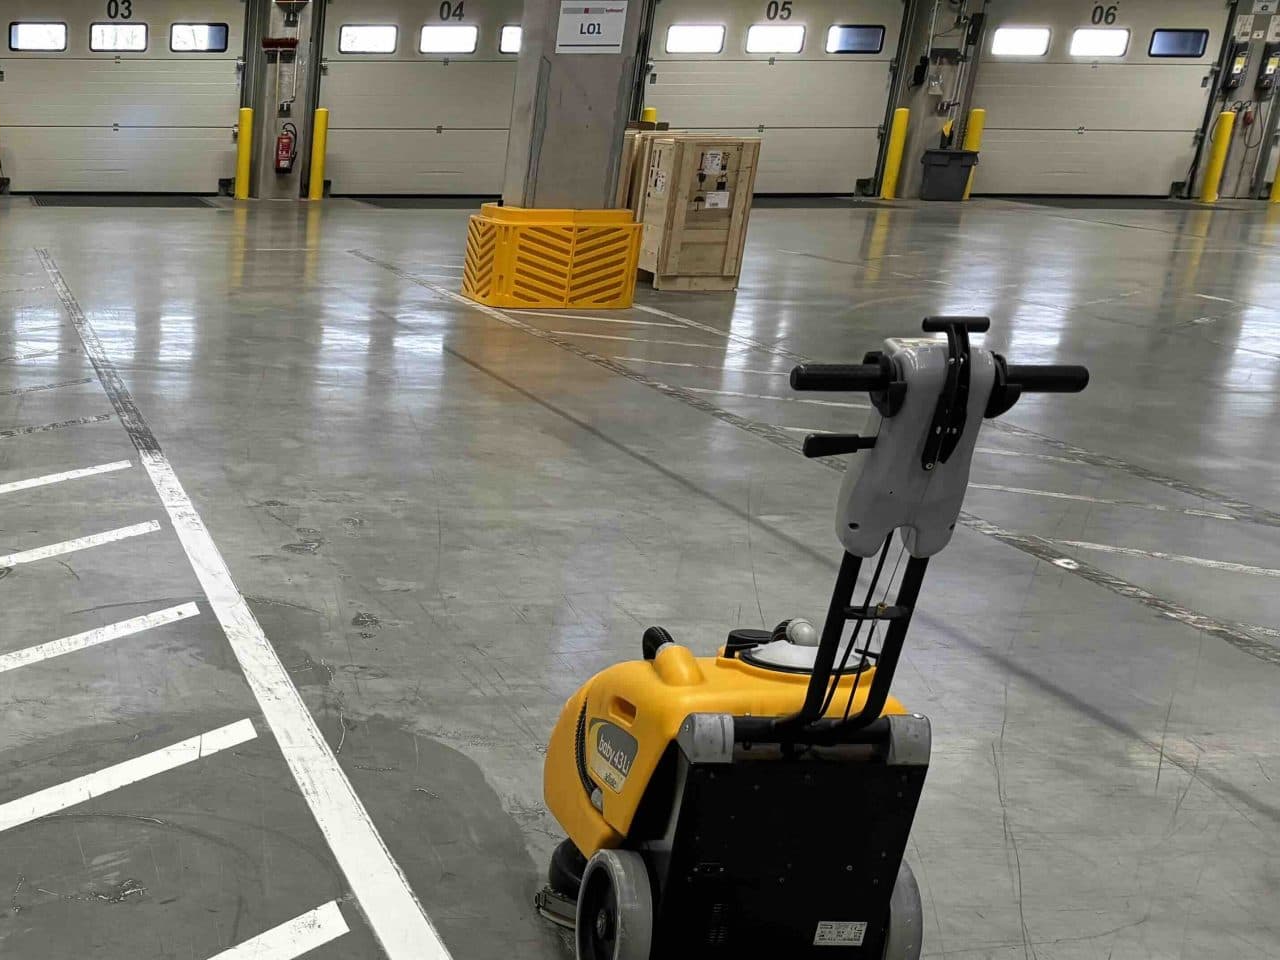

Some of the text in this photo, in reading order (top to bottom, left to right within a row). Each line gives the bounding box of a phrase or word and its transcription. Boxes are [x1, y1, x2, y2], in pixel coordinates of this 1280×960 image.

[107, 0, 132, 19] 03
[440, 1, 465, 21] 04
[767, 1, 792, 20] 05
[1092, 5, 1117, 25] 06
